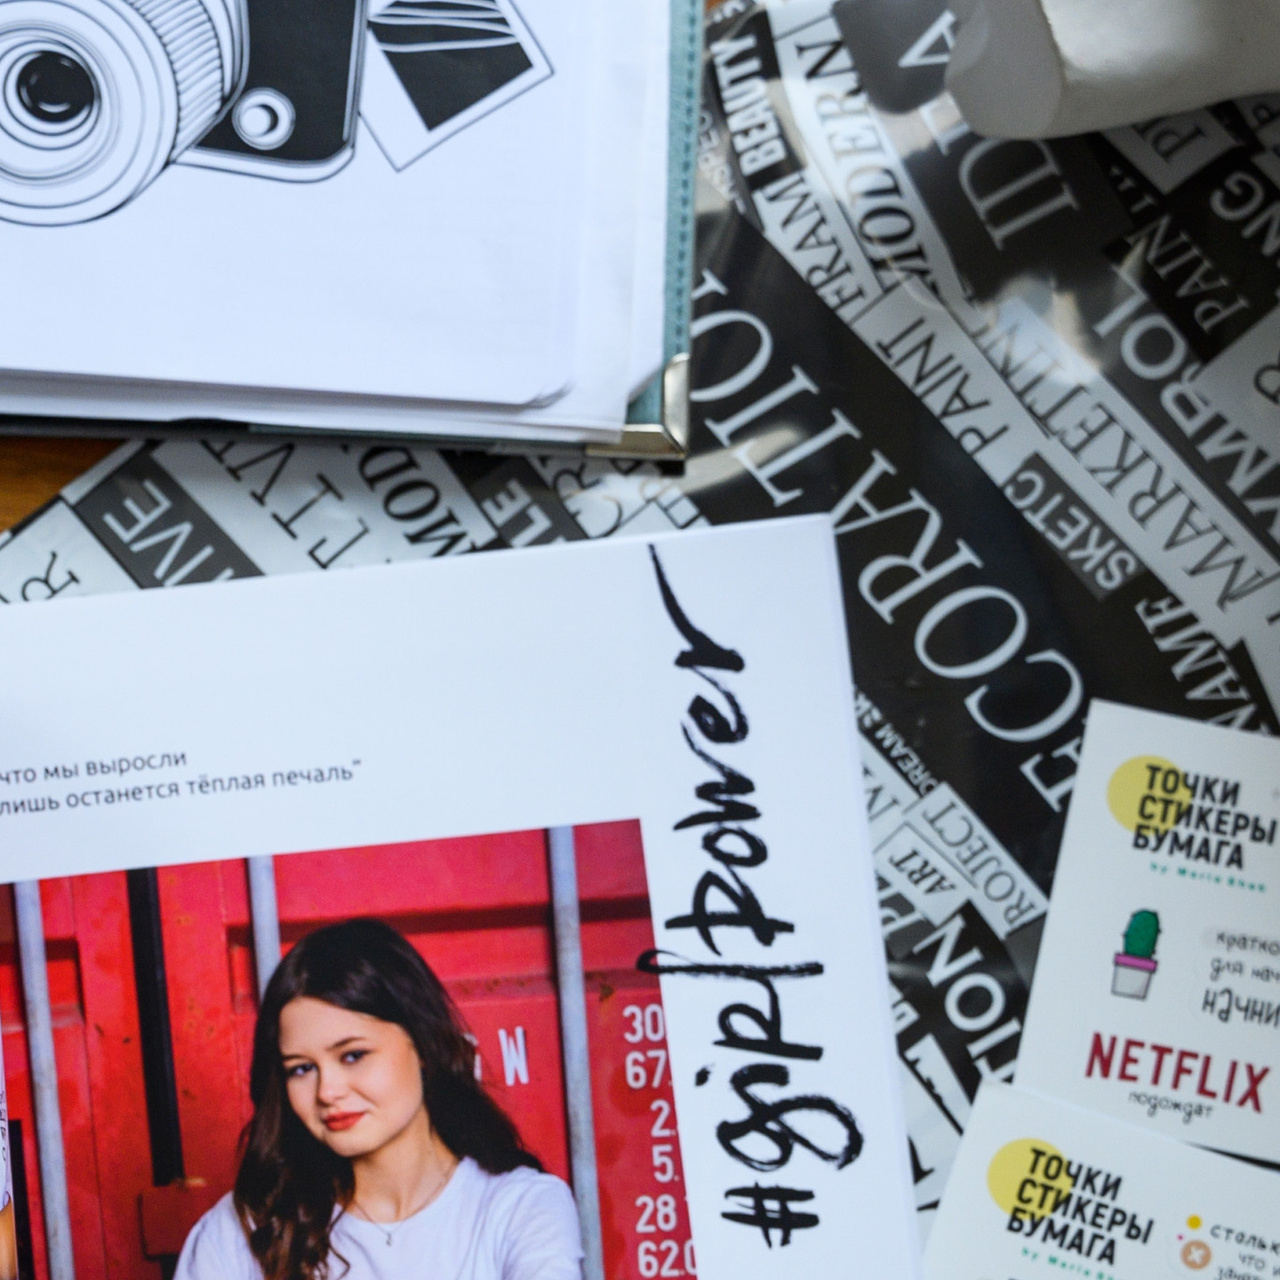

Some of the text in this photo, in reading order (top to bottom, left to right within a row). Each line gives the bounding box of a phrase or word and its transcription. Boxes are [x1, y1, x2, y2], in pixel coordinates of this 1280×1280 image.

[710, 33, 787, 177] BEAUTY
[876, 318, 1011, 458] PAINT
[43, 760, 80, 782] мы
[86, 750, 188, 778] выросли
[66, 781, 181, 810] останется
[187, 770, 266, 796] тёплая
[1145, 763, 1241, 807] ТОЧКИ
[1132, 823, 1244, 870] БУМАГА
[1138, 794, 1278, 846] СТИКЕРЫ
[890, 847, 958, 895] ART
[1085, 1031, 1271, 1114] NETFLIX
[1029, 1147, 1123, 1201] ТОЧКИ
[1006, 1206, 1116, 1266] БУМАГА
[1016, 1177, 1155, 1245] СТИКЕРЫ
